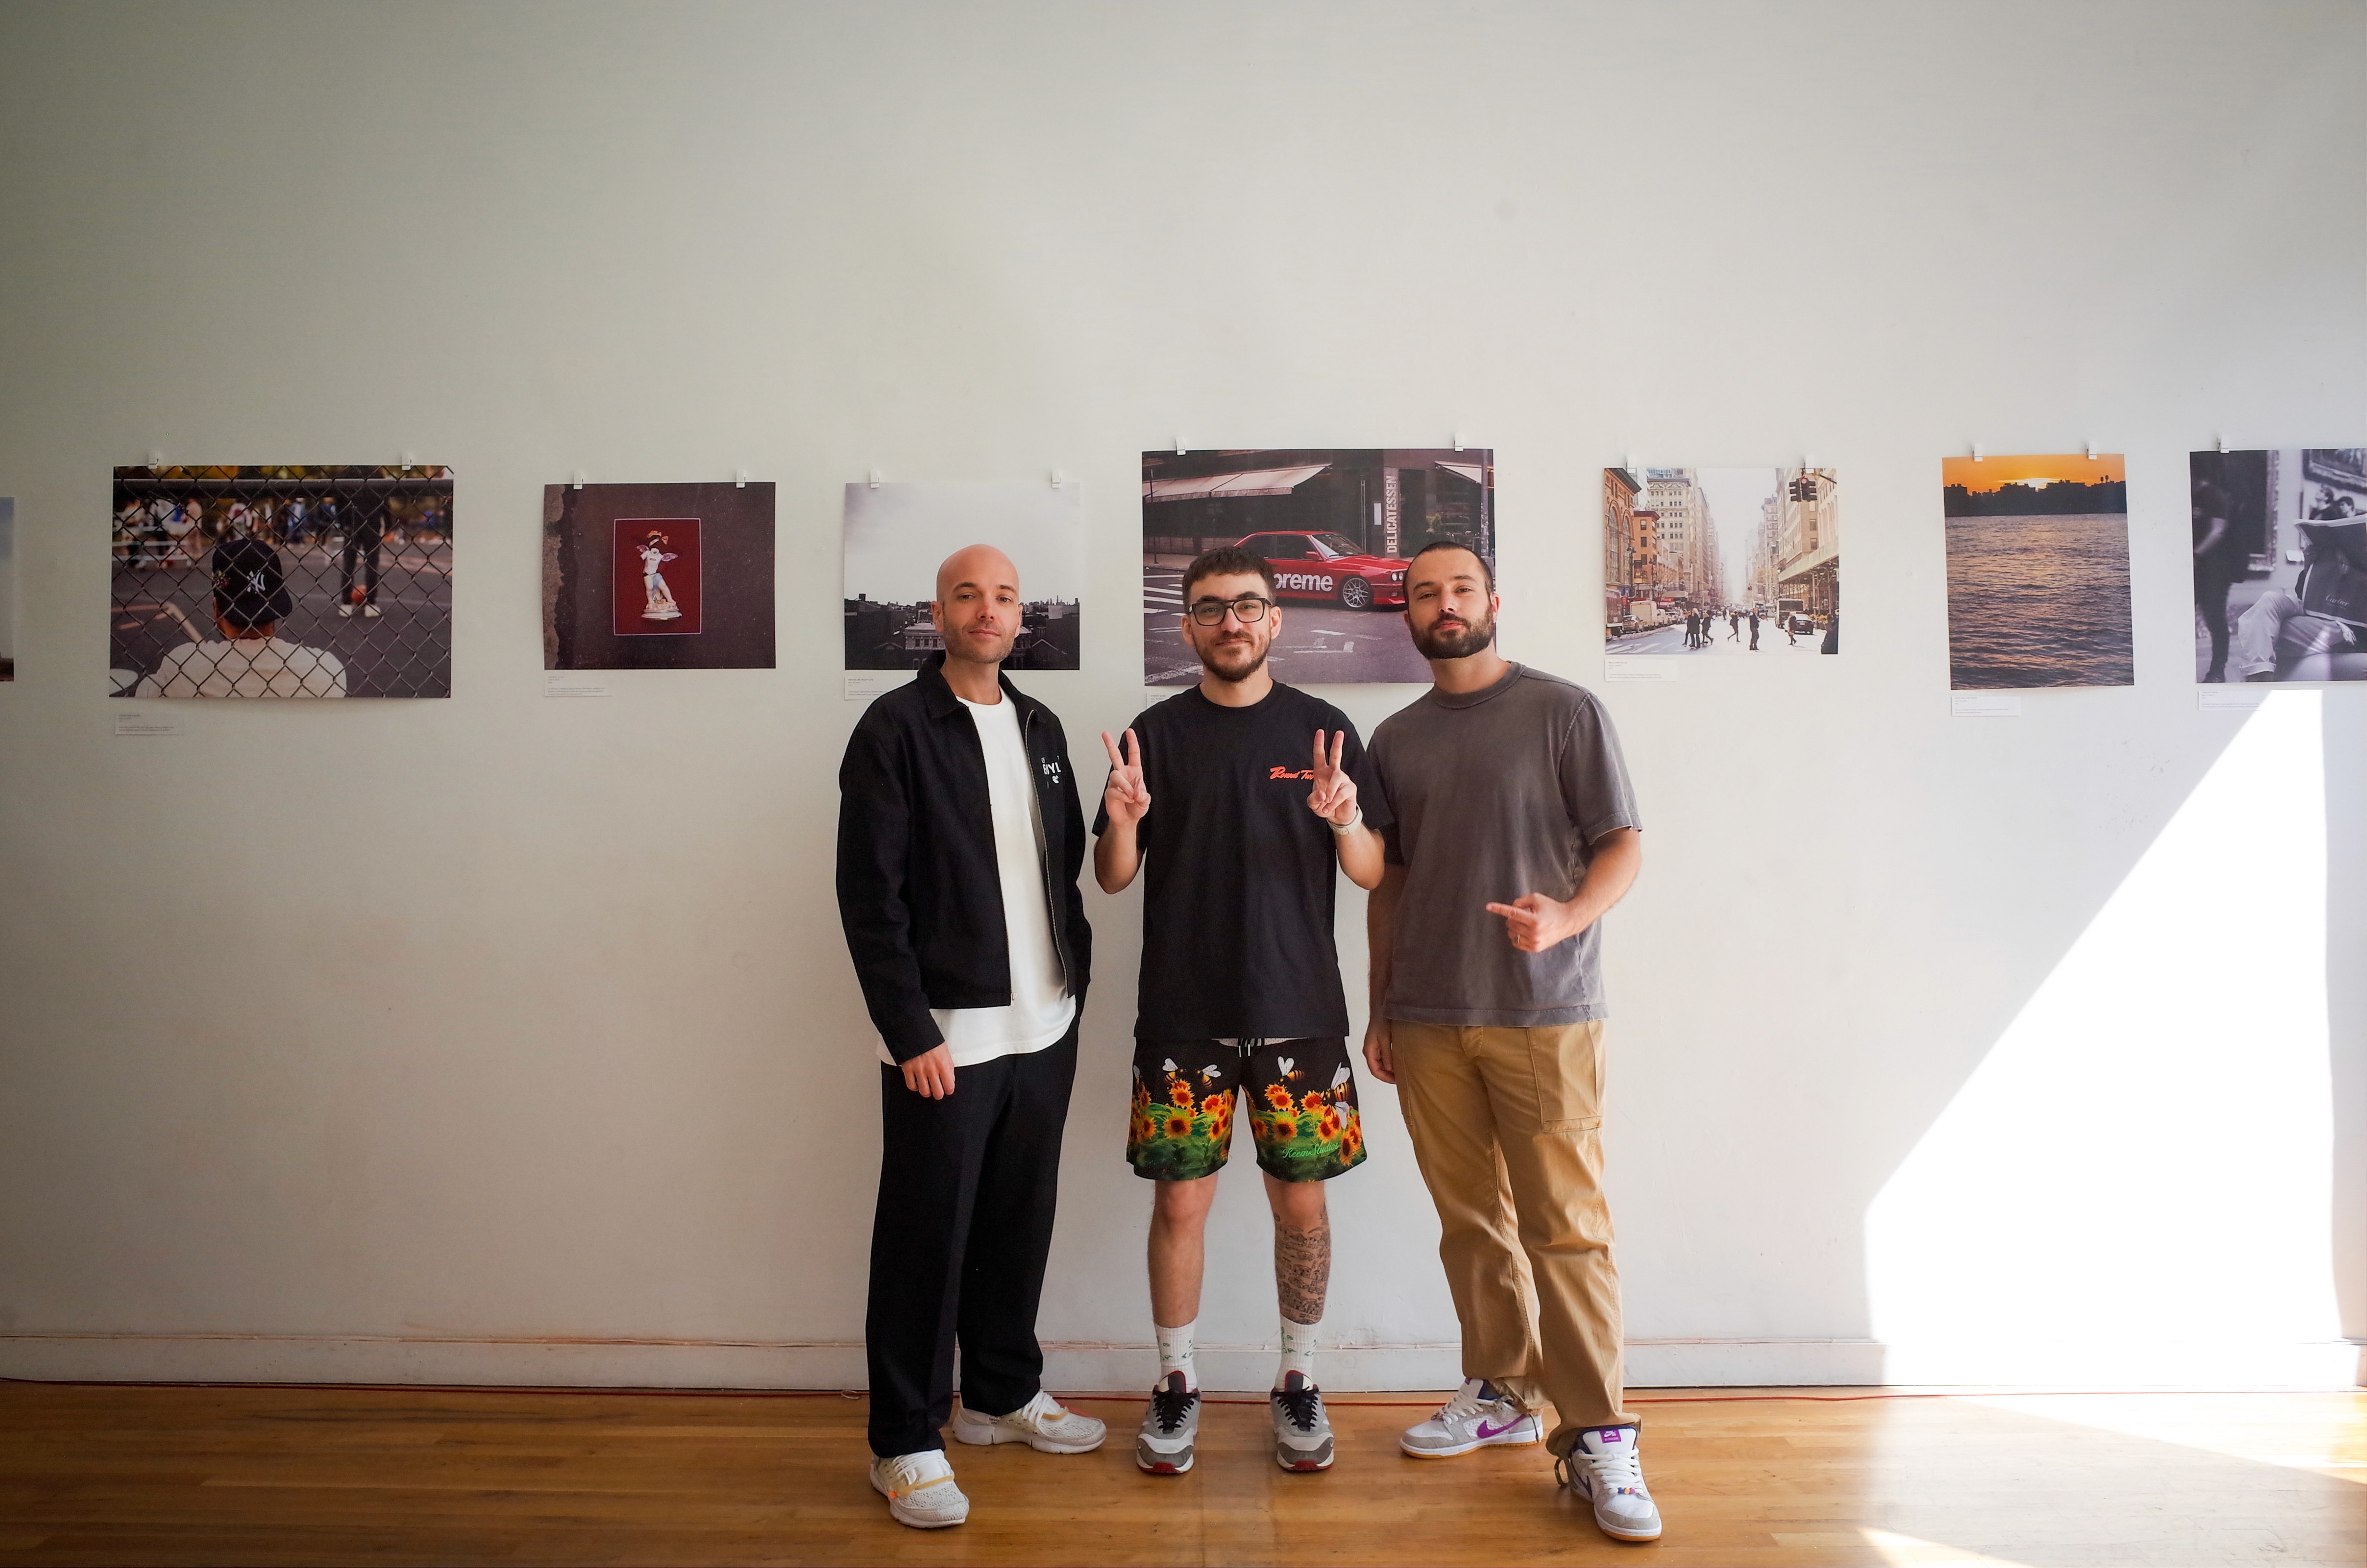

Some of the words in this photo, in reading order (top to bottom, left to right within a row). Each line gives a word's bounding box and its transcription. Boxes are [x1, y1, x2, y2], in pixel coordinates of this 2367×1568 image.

[1386, 475, 1397, 553] DELICATESSEN
[1273, 573, 1333, 592] preme
[2326, 594, 2349, 606] Cartier
[1270, 766, 1300, 779] Round
[1282, 1147, 1311, 1158] Keem
[1310, 1142, 1339, 1156] Studios
